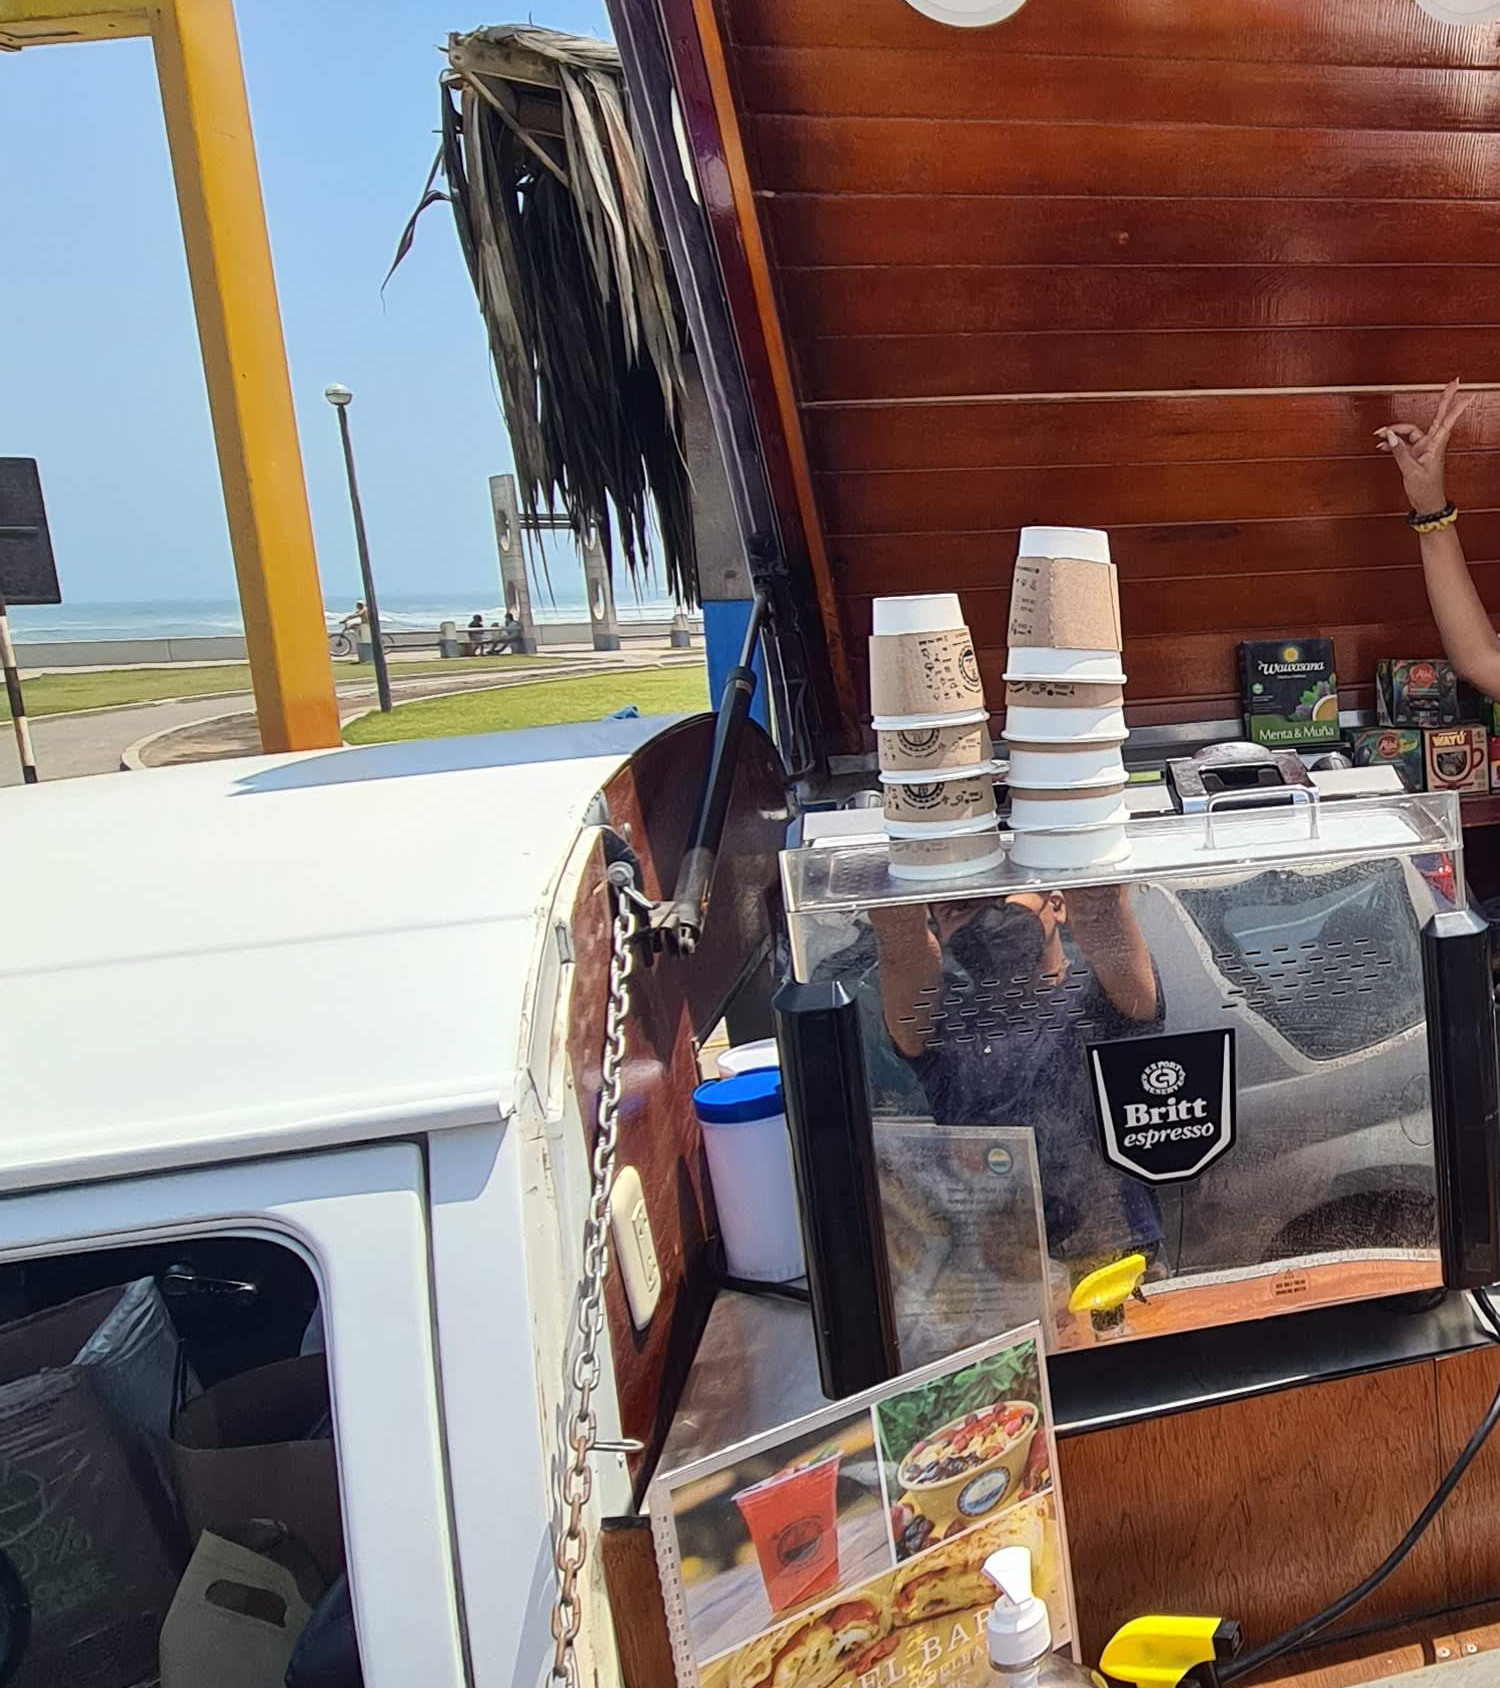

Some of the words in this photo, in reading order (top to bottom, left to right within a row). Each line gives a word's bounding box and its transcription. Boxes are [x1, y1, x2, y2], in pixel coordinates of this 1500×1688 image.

[1258, 660, 1325, 675] Wawasana
[1260, 729, 1293, 741] Menta
[1294, 727, 1303, 738] &
[1303, 724, 1334, 738] Muña
[1123, 1097, 1208, 1128] Britt
[1123, 1122, 1215, 1150] espresso
